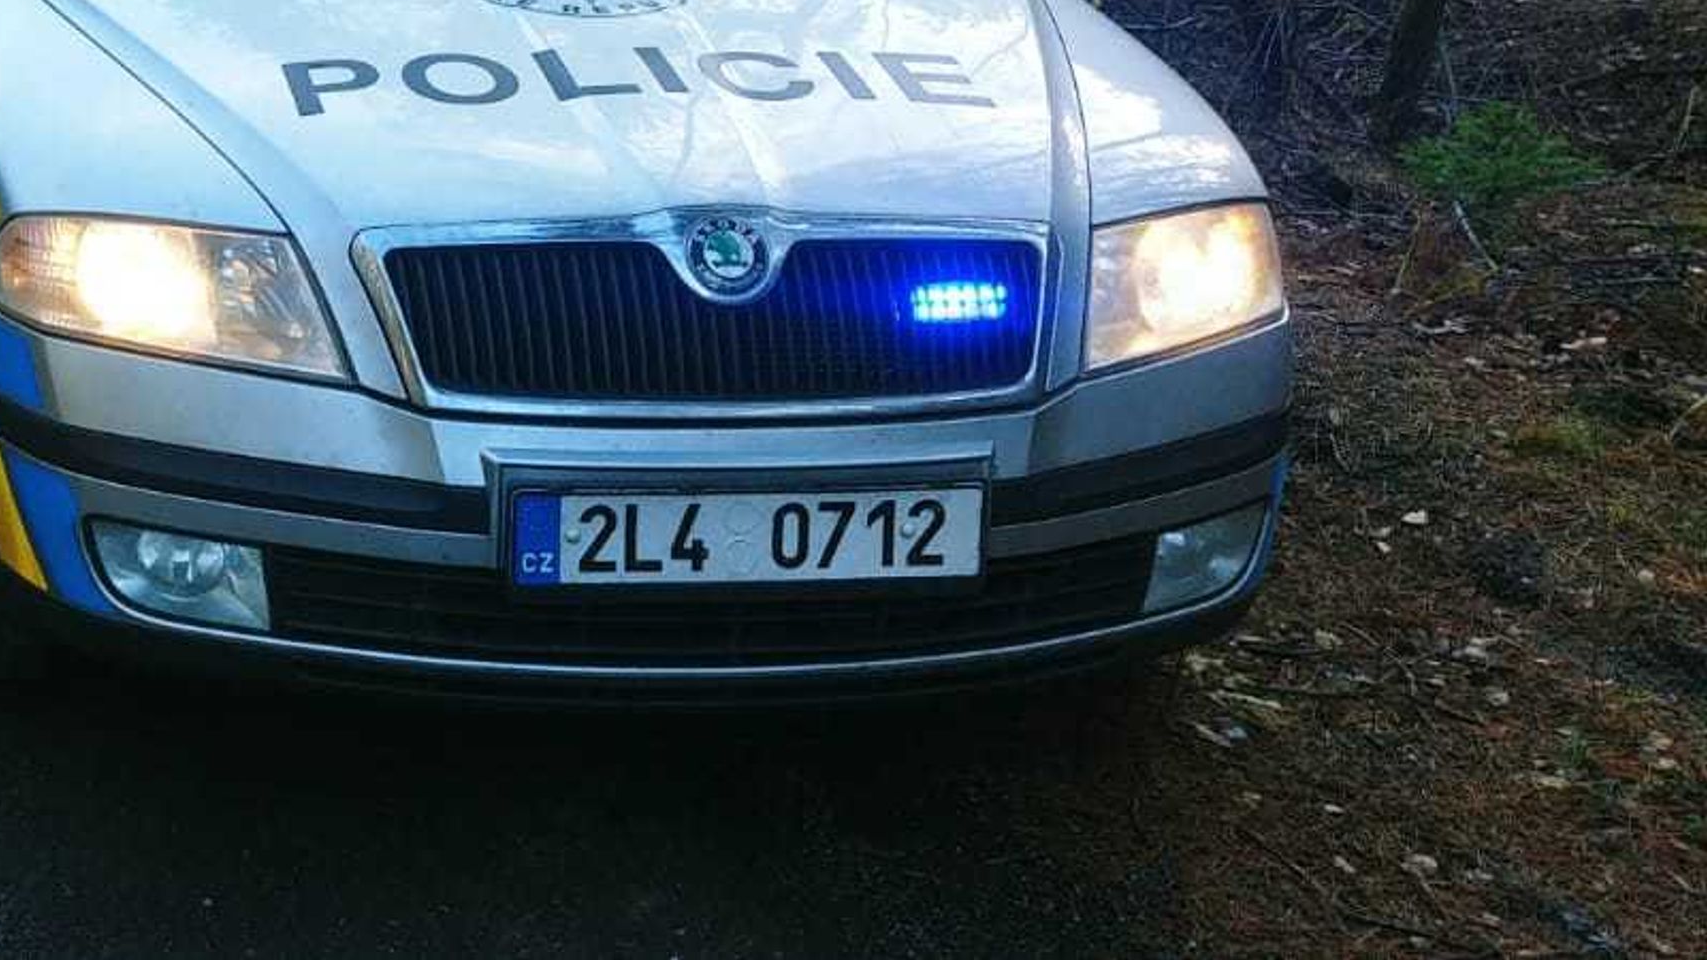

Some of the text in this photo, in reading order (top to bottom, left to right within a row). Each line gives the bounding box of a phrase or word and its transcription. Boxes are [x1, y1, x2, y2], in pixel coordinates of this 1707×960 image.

[280, 45, 996, 117] POLICIE
[521, 552, 554, 573] CZ
[578, 499, 946, 572] 2L4 0712
